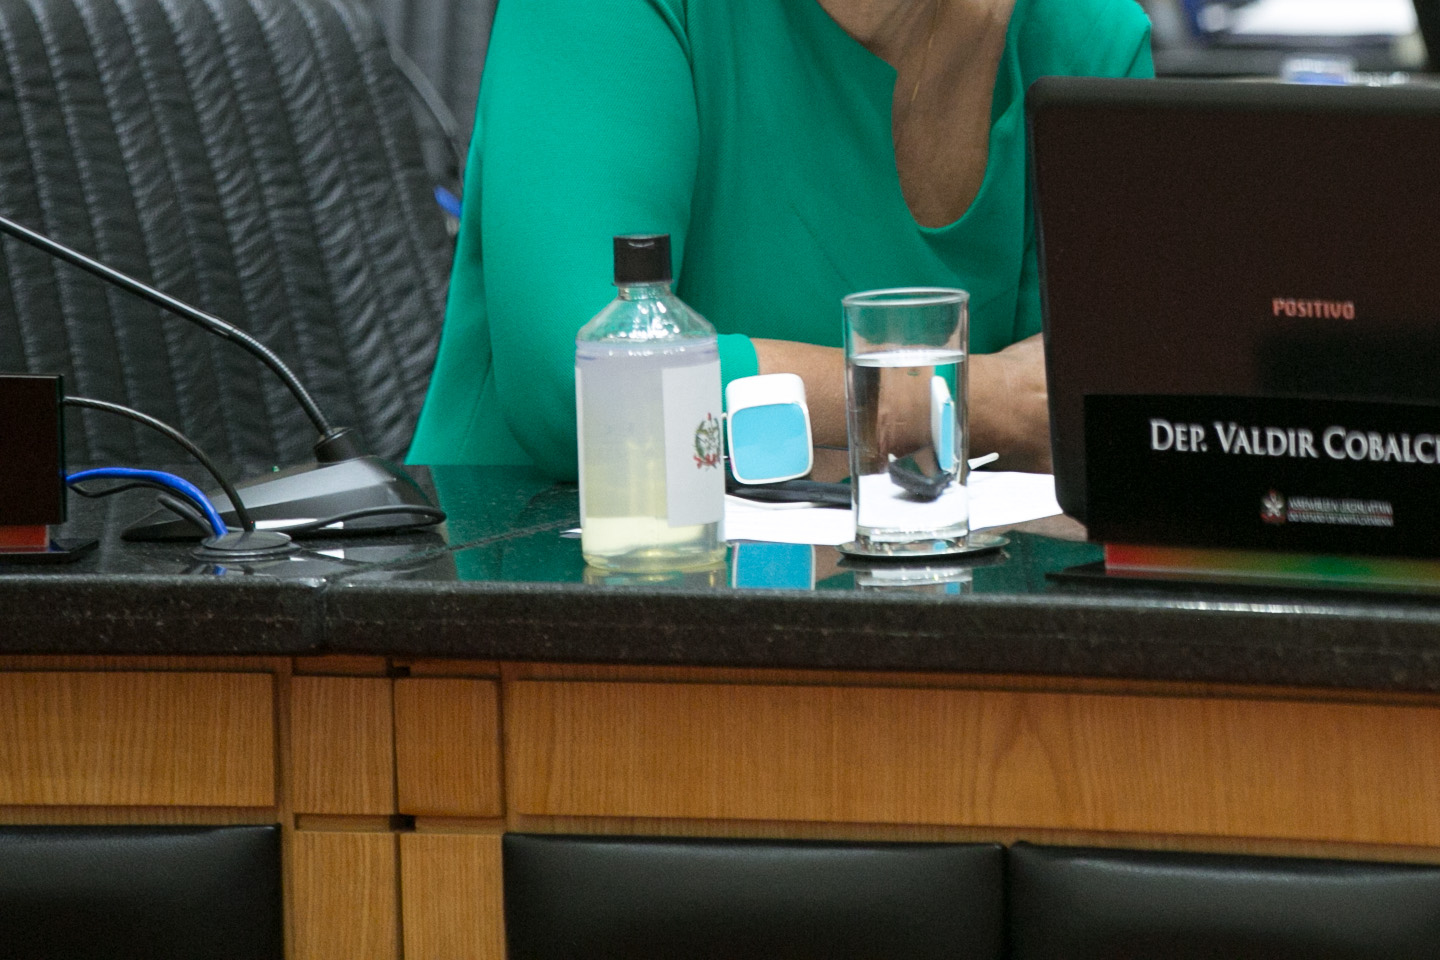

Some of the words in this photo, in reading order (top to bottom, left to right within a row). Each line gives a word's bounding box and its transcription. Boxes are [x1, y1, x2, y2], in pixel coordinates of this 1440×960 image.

[1272, 298, 1355, 320] POSITIVO
[1150, 418, 1207, 452] DEP.
[1213, 421, 1319, 458] VALDIR
